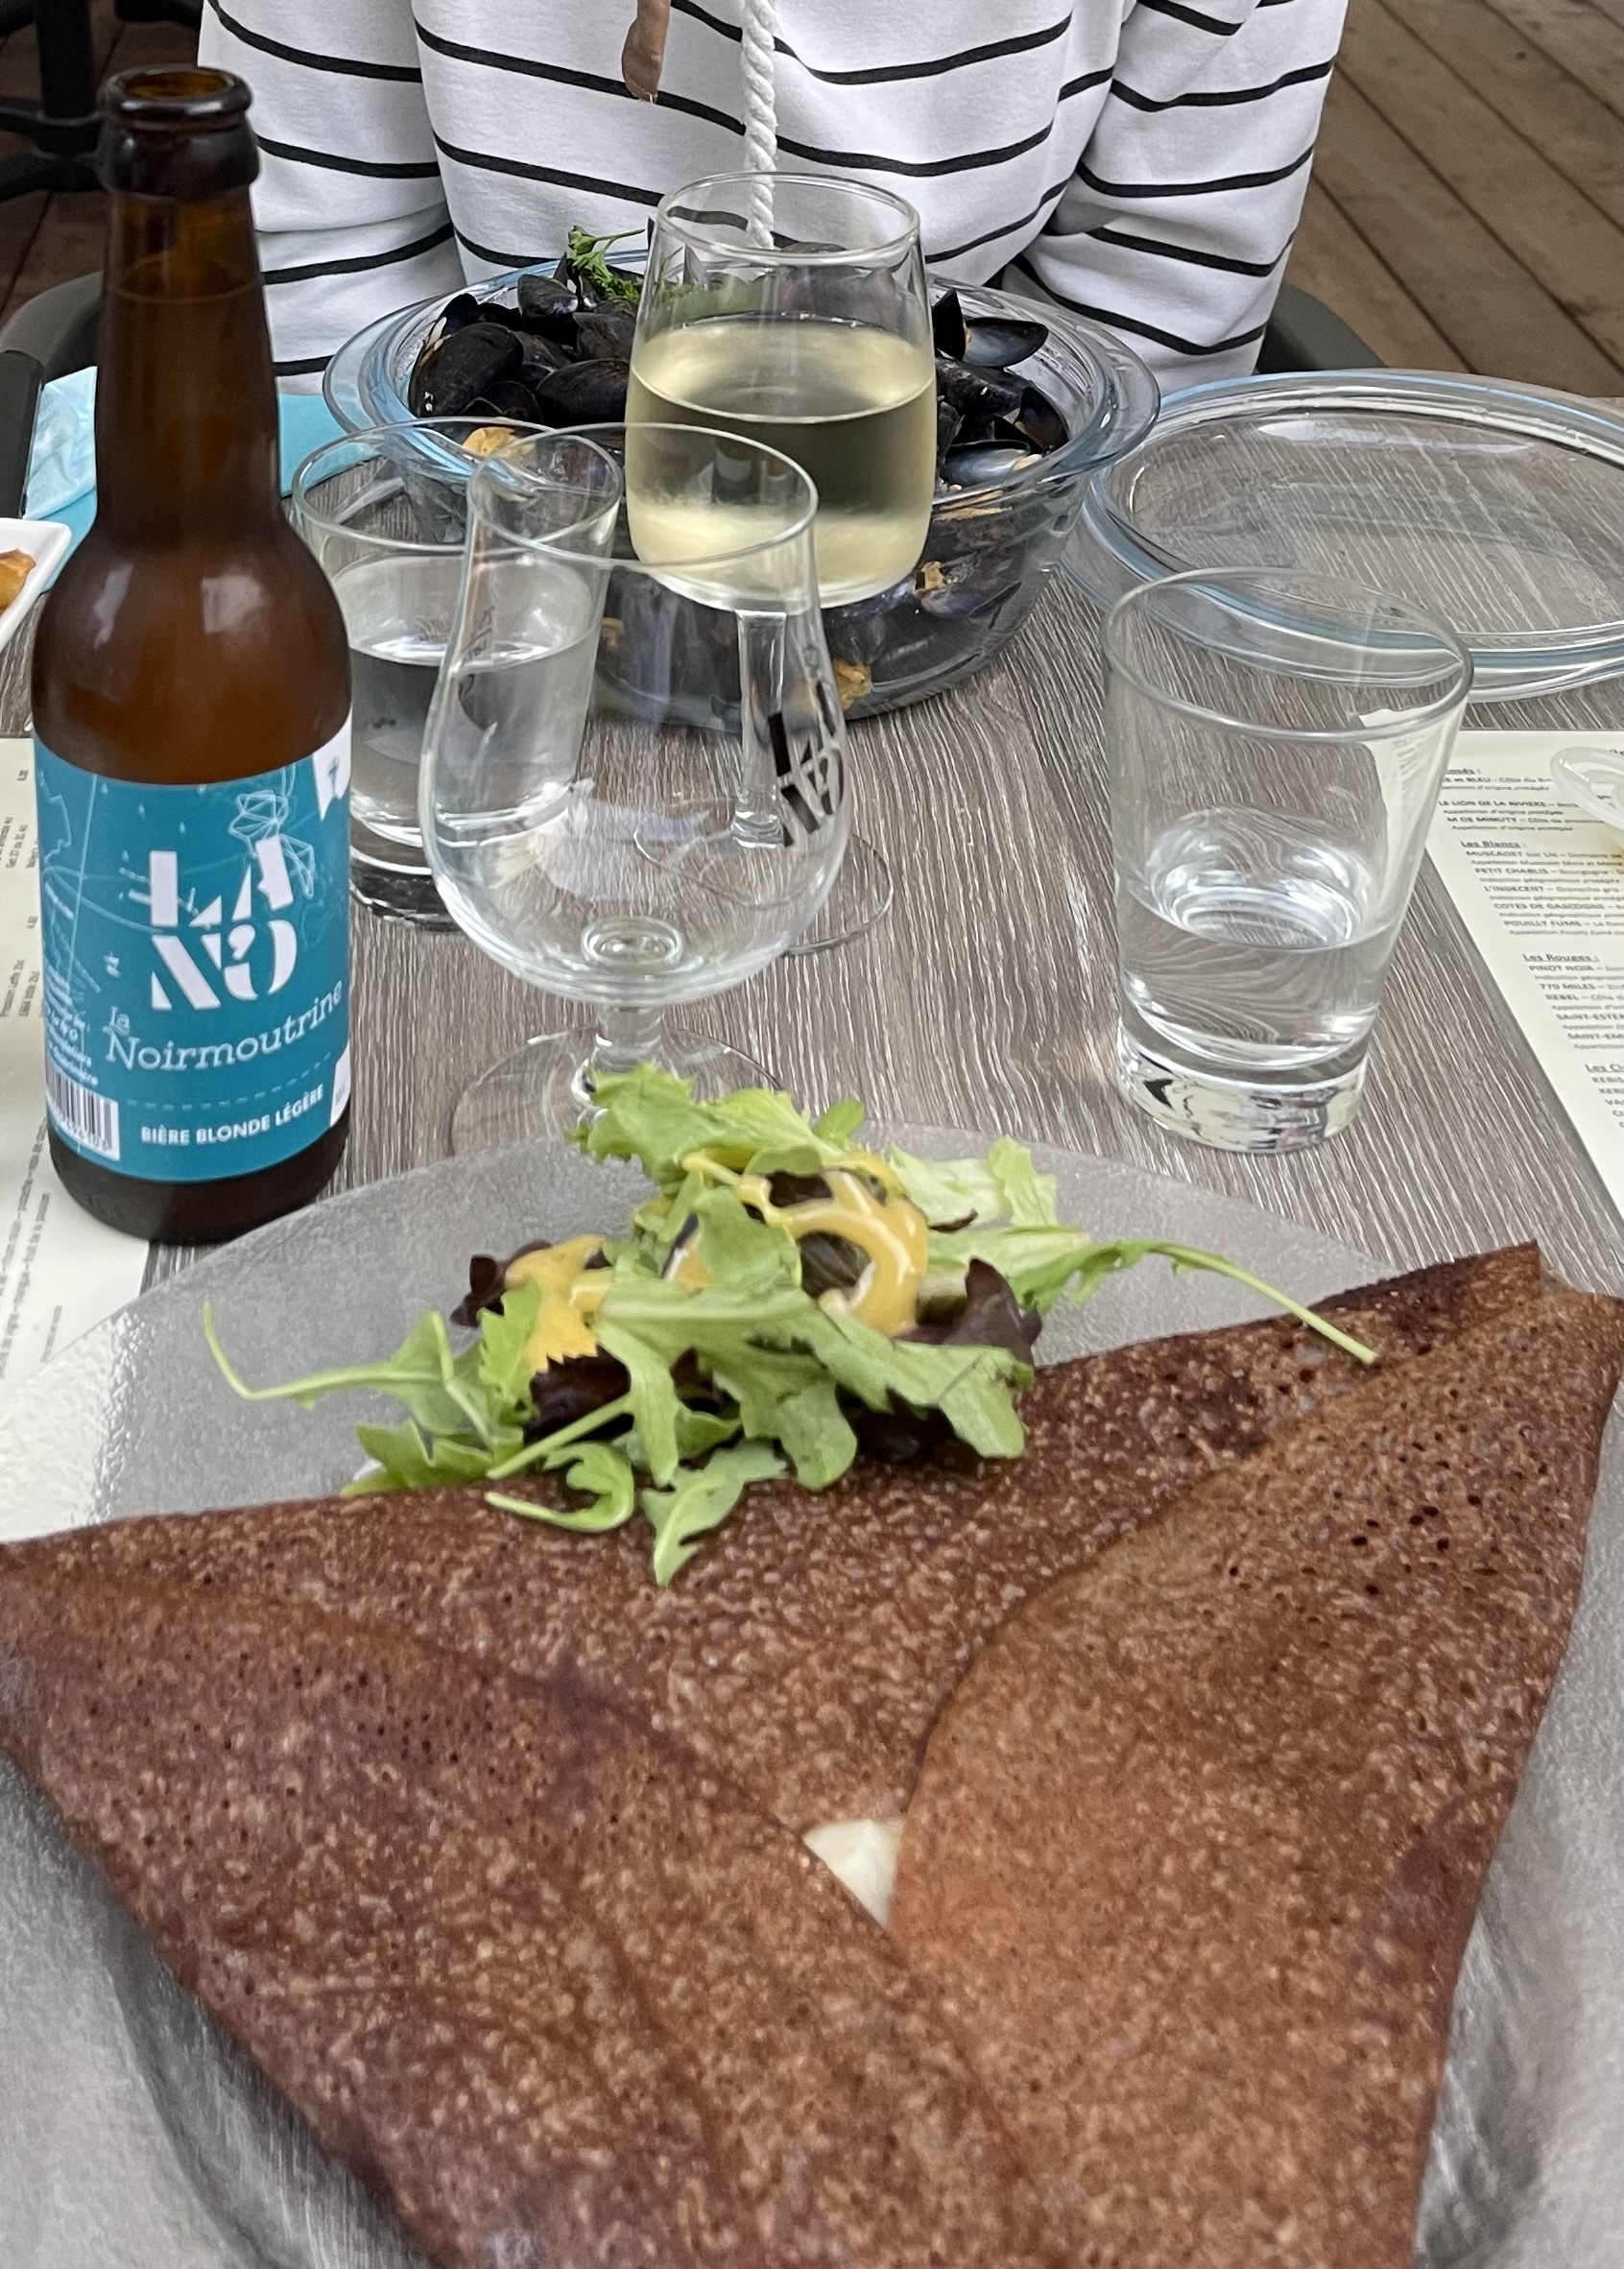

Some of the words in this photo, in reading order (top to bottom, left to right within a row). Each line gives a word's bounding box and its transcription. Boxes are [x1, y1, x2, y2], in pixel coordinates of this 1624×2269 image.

[103, 978, 344, 1072] Noirmoutrine
[140, 1122, 190, 1147] BIÈRE
[195, 1113, 272, 1145] BLONDE
[275, 1083, 324, 1126] LÉGÈRE
